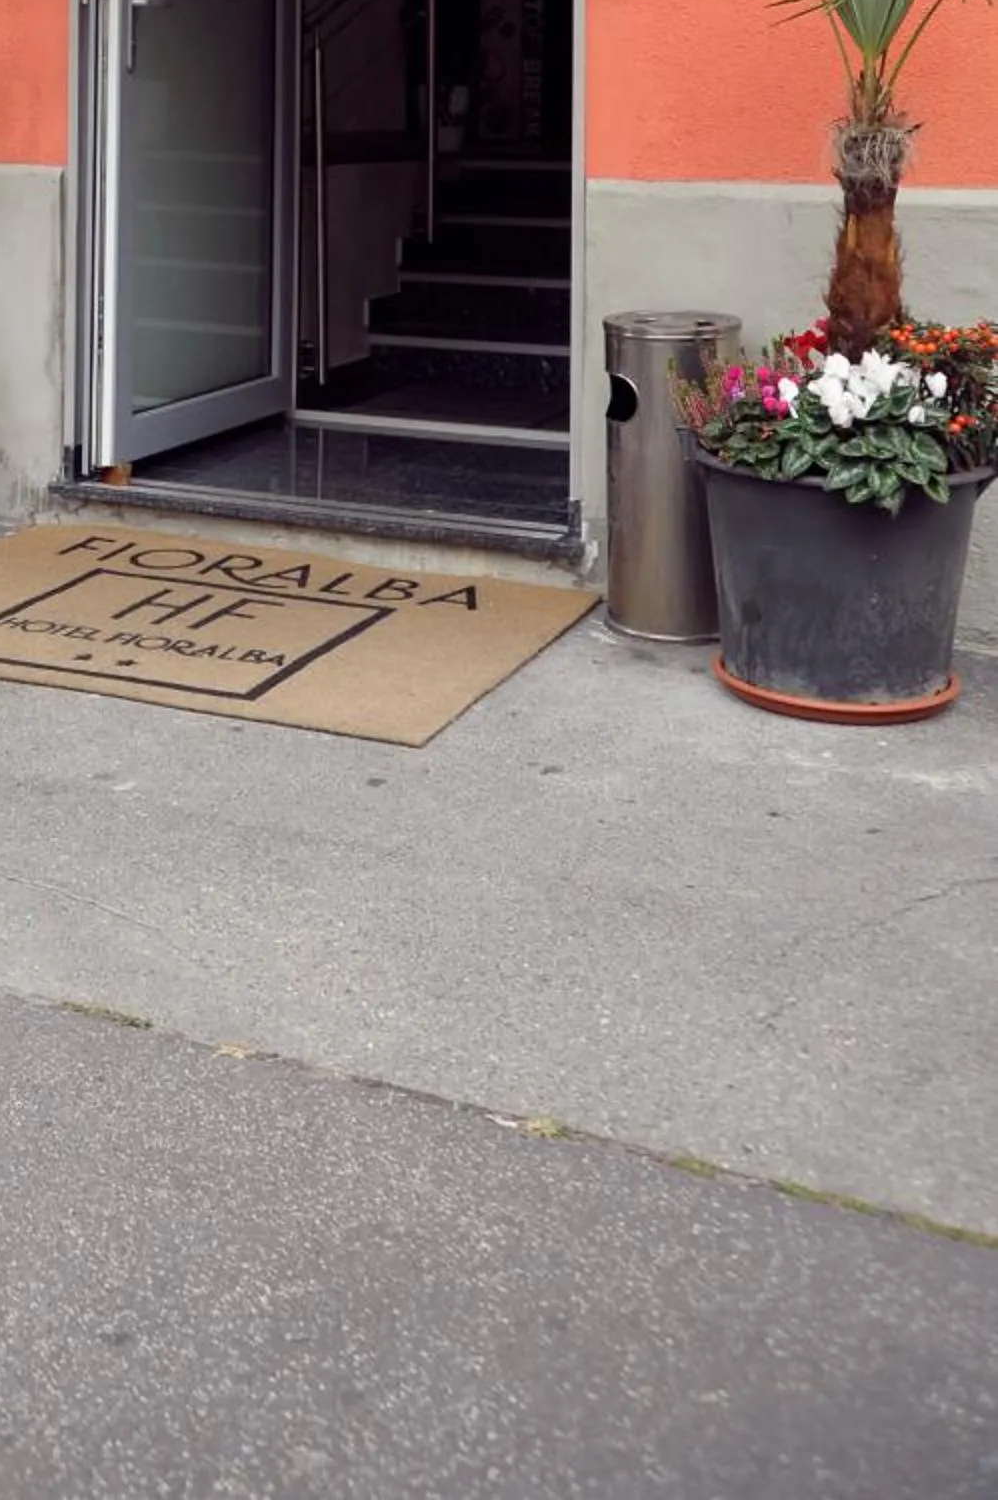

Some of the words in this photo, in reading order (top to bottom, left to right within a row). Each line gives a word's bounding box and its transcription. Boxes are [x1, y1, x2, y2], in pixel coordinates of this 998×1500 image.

[58, 534, 479, 612] FIORALBA
[111, 588, 286, 630] HF
[0, 616, 102, 642] HOTEL
[103, 631, 286, 667] FIORALBA
